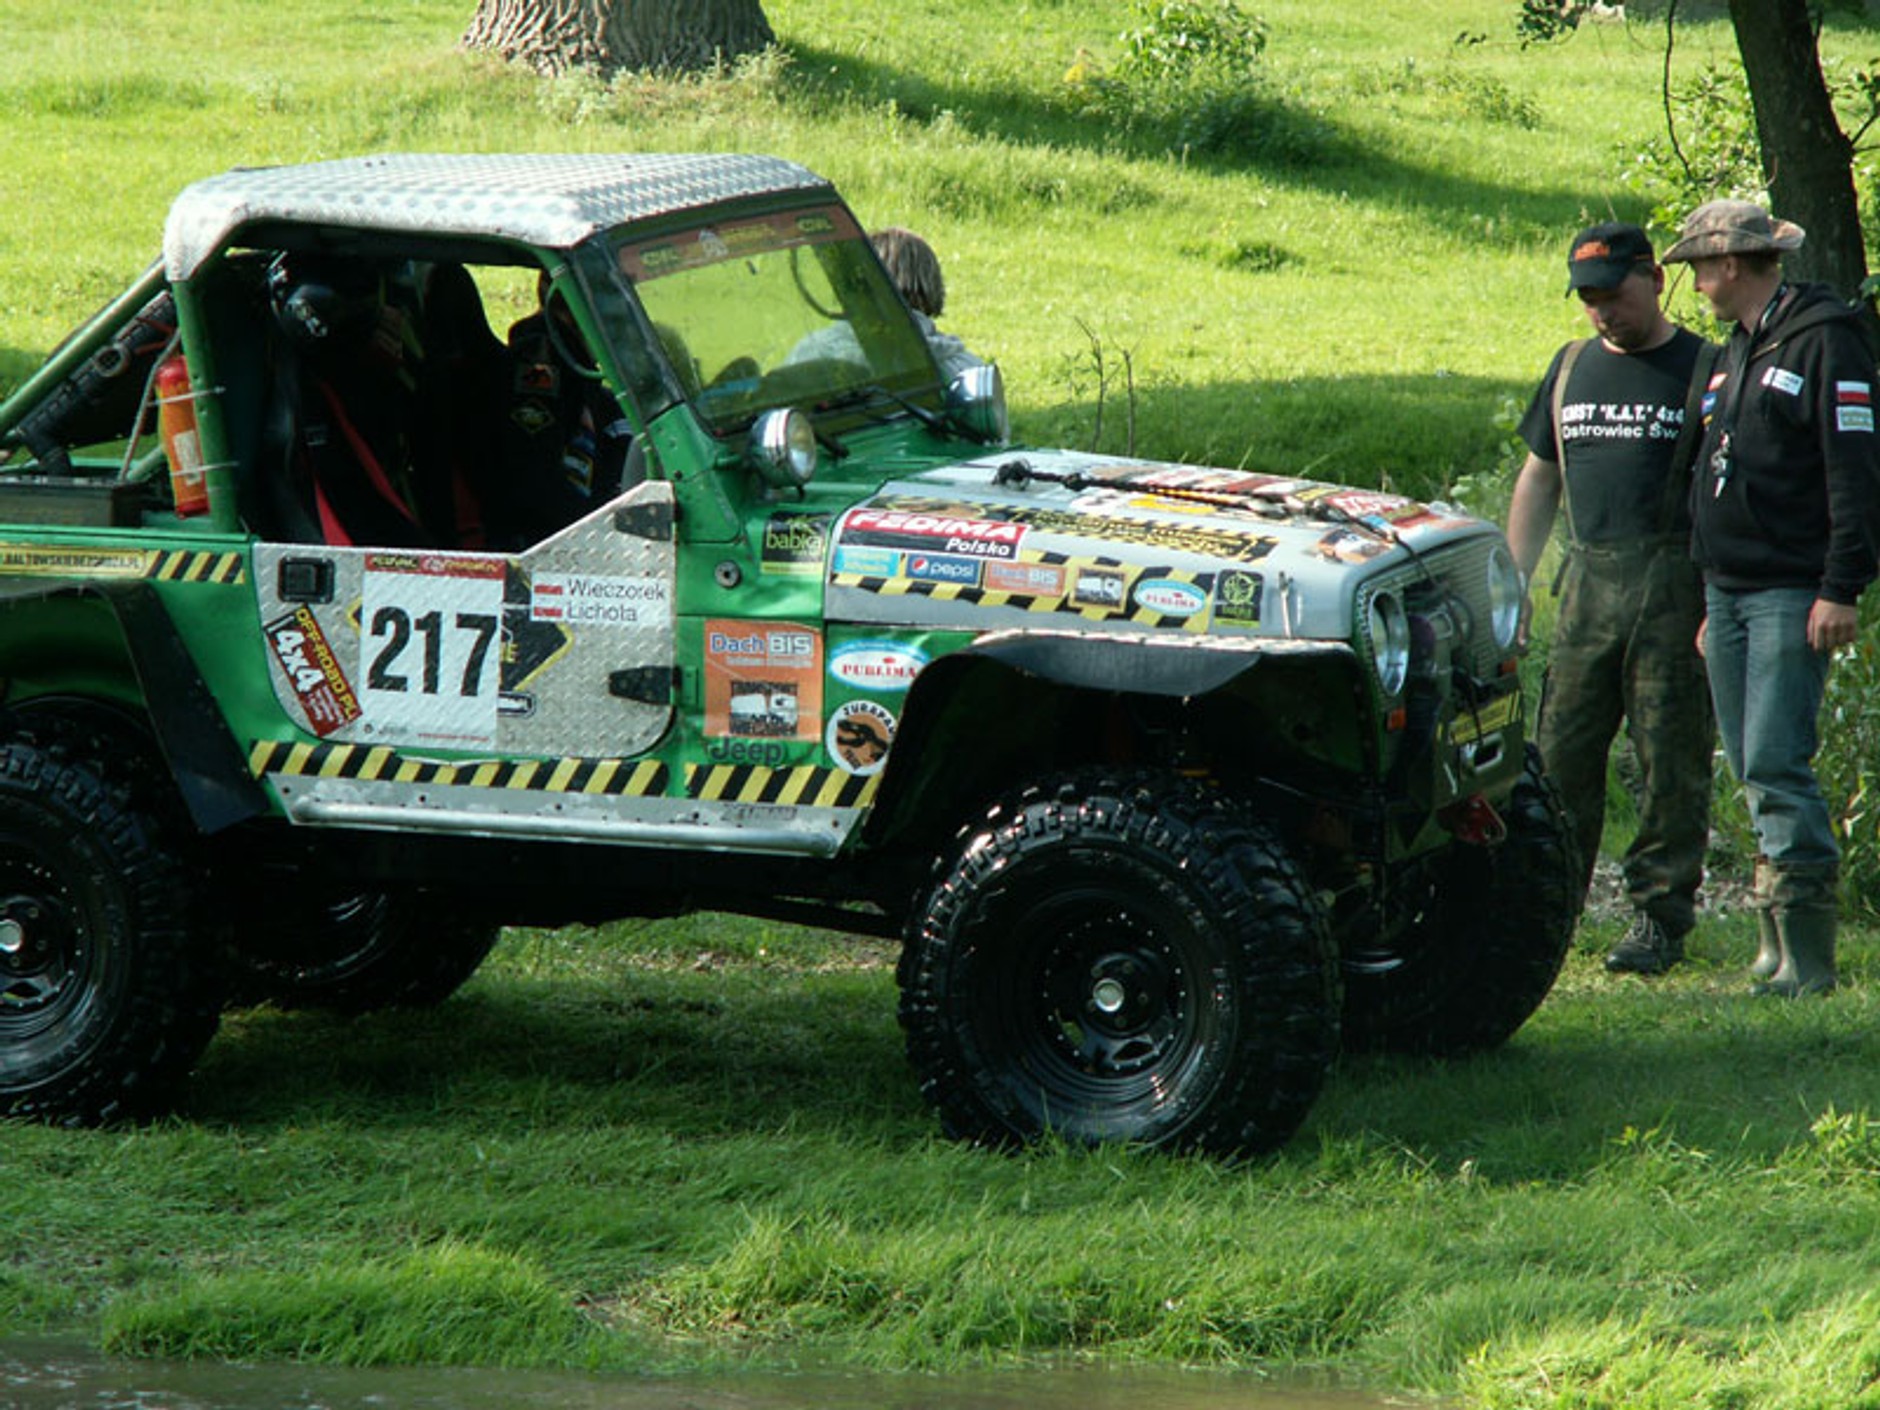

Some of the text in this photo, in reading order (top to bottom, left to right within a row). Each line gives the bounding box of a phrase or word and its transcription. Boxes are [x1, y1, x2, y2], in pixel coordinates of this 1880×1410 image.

[1562, 422, 1644, 440] Ostrowiec
[930, 562, 974, 578] pepsi
[567, 578, 665, 600] Wieczorek
[367, 605, 498, 696] 217
[710, 632, 812, 655] Dach BIS
[275, 629, 325, 694] 4x4
[710, 736, 783, 767] Jeep
